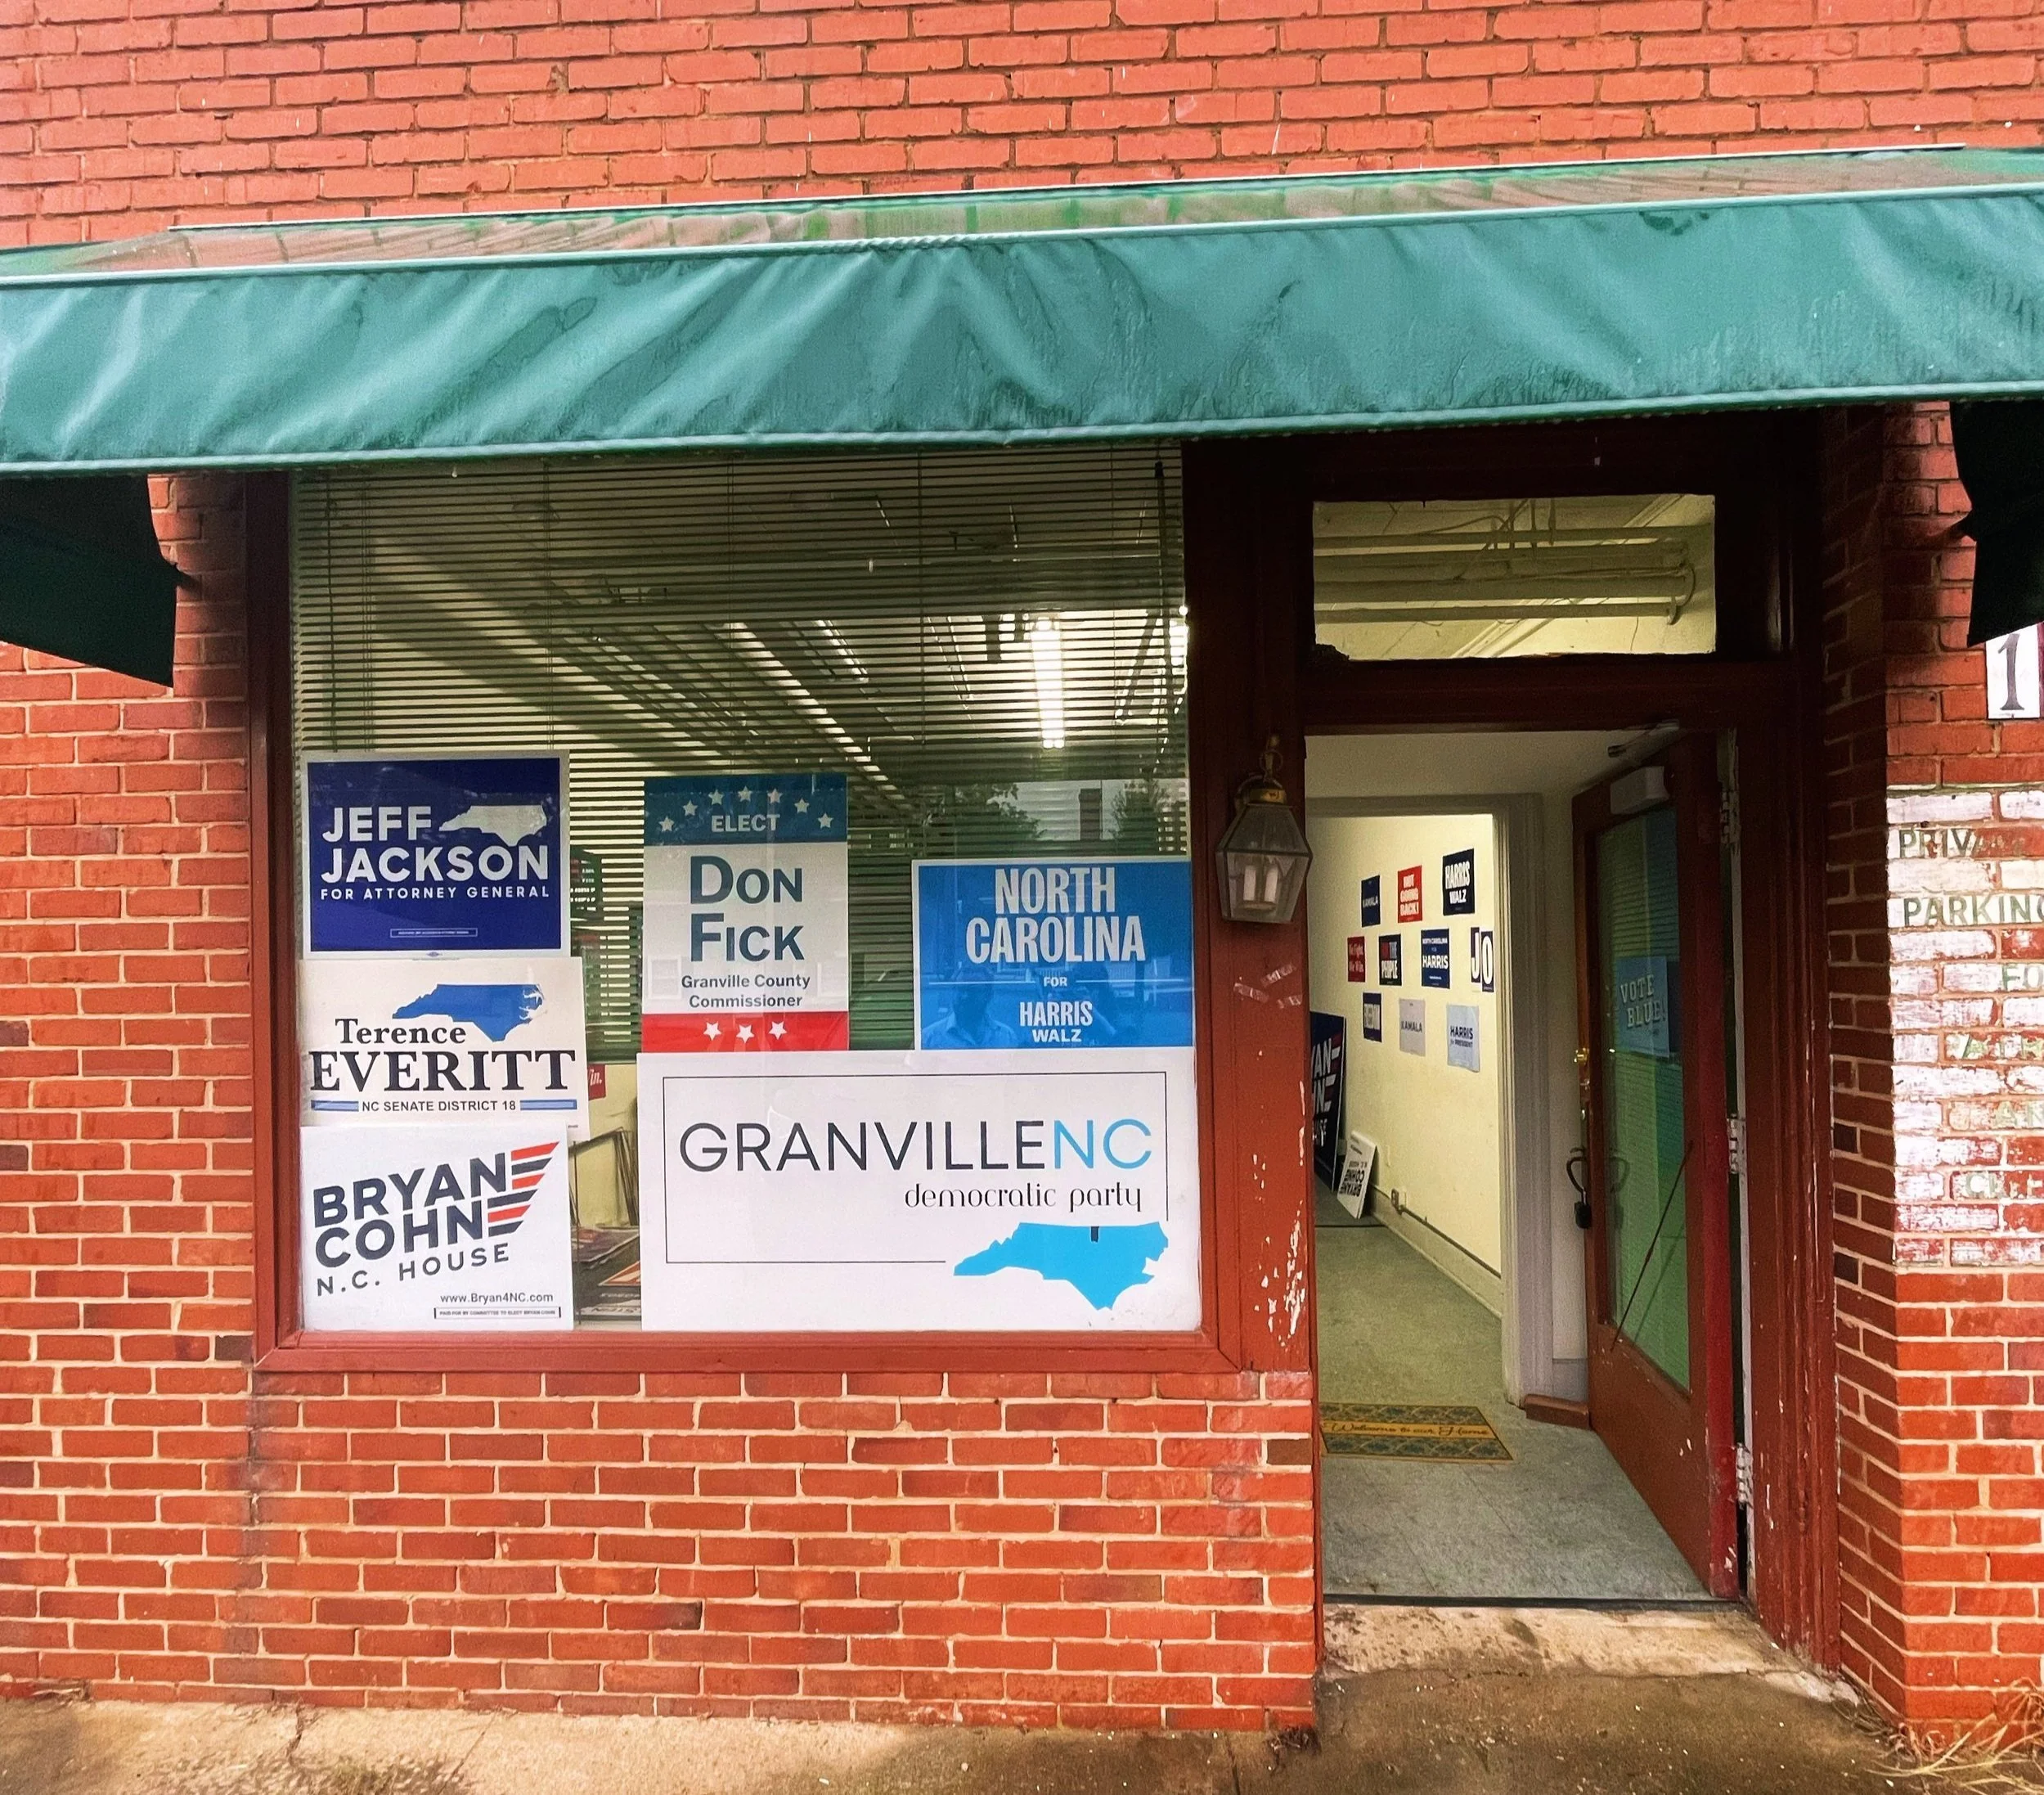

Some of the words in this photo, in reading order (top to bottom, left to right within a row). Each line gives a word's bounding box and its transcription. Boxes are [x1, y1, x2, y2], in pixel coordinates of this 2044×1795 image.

[1997, 633, 2025, 711] 1
[321, 806, 432, 842] JEFF
[711, 814, 780, 832] ELECT
[321, 845, 549, 883] JACKSON
[1444, 861, 1471, 889] HARRIS
[321, 889, 354, 900] FOR
[363, 886, 457, 899] ATTORNEY
[466, 885, 549, 898] GENERAL
[995, 866, 1116, 915] NORTH
[1449, 889, 1467, 904] WALZ
[966, 915, 1146, 964] CAROLINA
[1422, 955, 1449, 969] HARRIS
[681, 974, 750, 988] Granville
[754, 974, 811, 989] County
[1043, 977, 1067, 987] FOR
[1620, 974, 1655, 1003] VOTE
[689, 995, 802, 1008] Commissioner
[1020, 1000, 1093, 1027] HARRIS
[335, 1018, 466, 1045] Terence
[1032, 1028, 1082, 1043] WALZ
[1449, 1025, 1474, 1040] HARRIS
[308, 1050, 576, 1092] EVERITT
[362, 1101, 380, 1112] NC
[384, 1100, 434, 1112] SENATE
[438, 1100, 499, 1111] DISTRICT
[502, 1100, 516, 1111] 18
[679, 1118, 1152, 1172] GRANVILLENC
[312, 1152, 506, 1228] BRYAN
[905, 1182, 1057, 1209] democratic
[1070, 1182, 1142, 1212] party
[315, 1200, 483, 1268] COHN
[317, 1270, 380, 1297] N.C.
[399, 1242, 510, 1281] HOUSE
[440, 1292, 554, 1305] www.Bryan4NC.com
